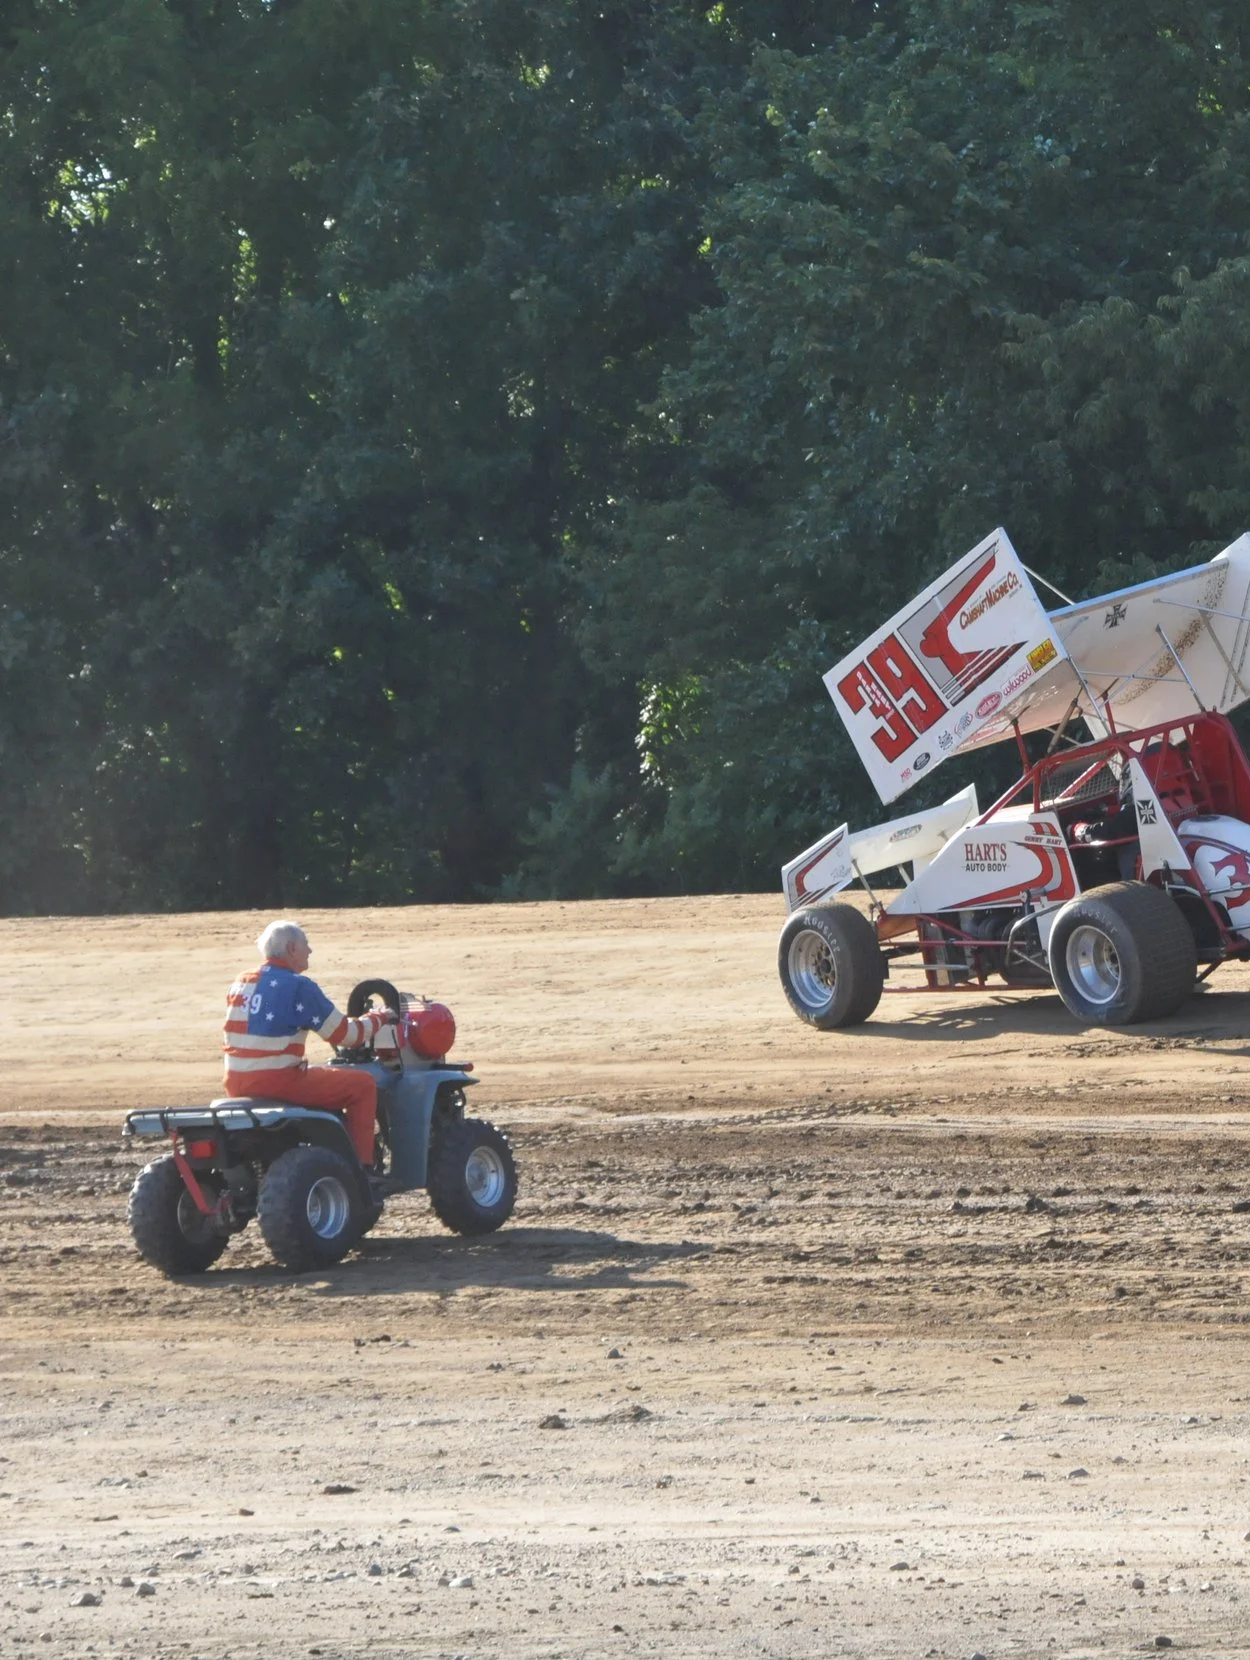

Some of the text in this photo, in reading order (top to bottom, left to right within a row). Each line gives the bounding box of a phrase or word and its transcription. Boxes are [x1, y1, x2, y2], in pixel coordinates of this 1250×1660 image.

[837, 632, 949, 763] 39
[964, 843, 1007, 861] HART'S
[965, 863, 1007, 872] AUTO BODY
[240, 994, 263, 1015] 39
